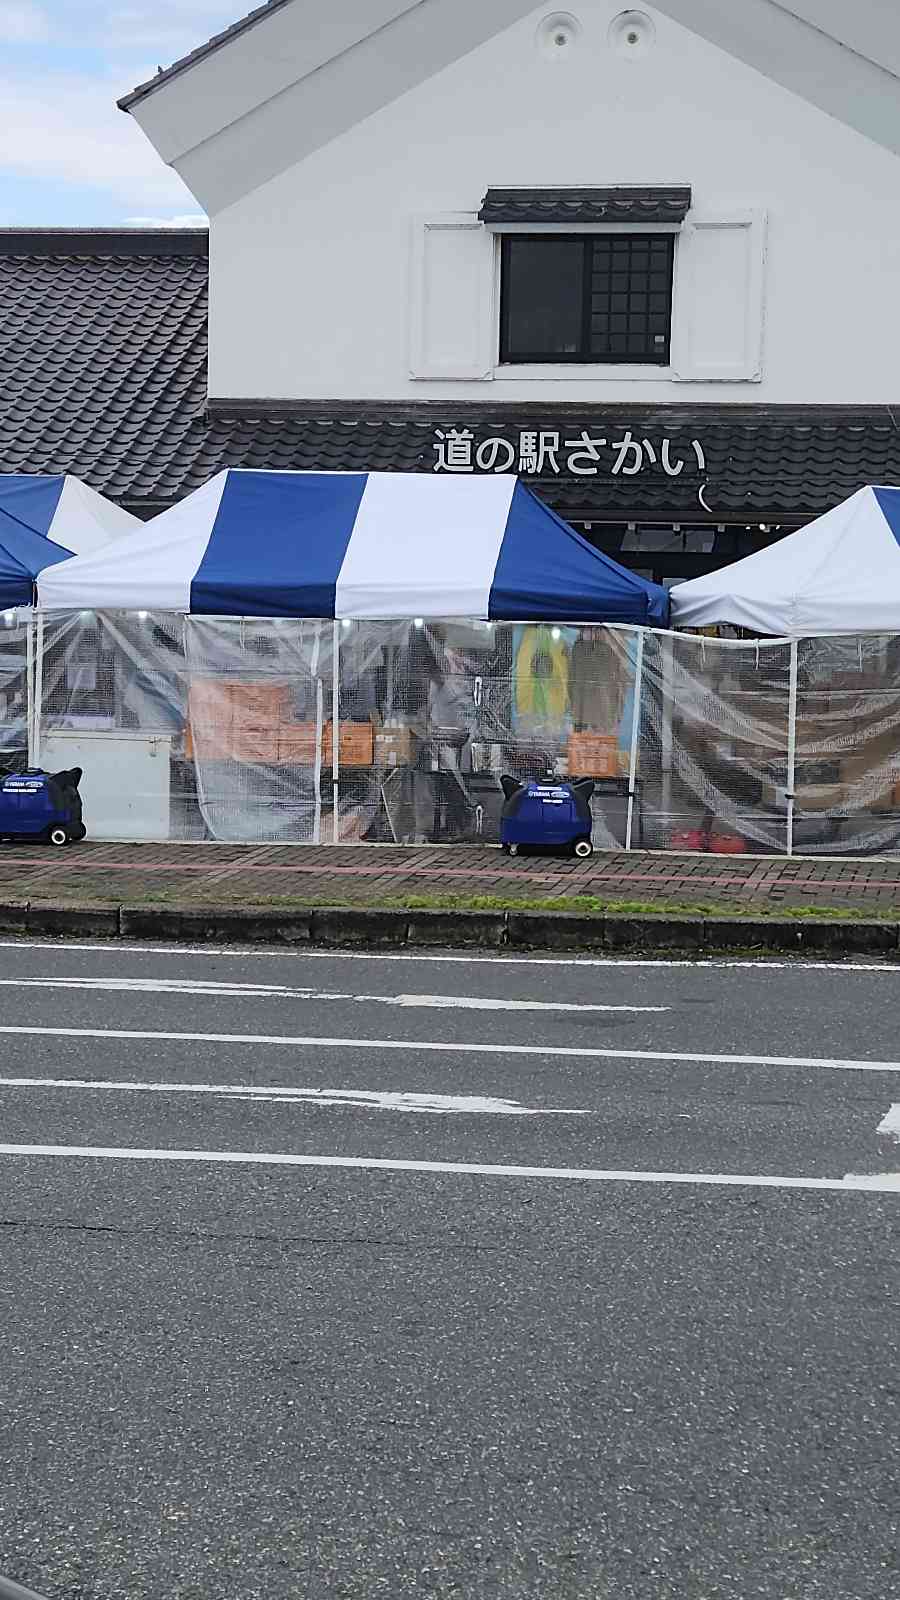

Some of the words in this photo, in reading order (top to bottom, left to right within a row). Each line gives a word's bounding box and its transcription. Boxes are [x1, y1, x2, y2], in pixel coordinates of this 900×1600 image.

[433, 428, 705, 476] 道の駅さかい
